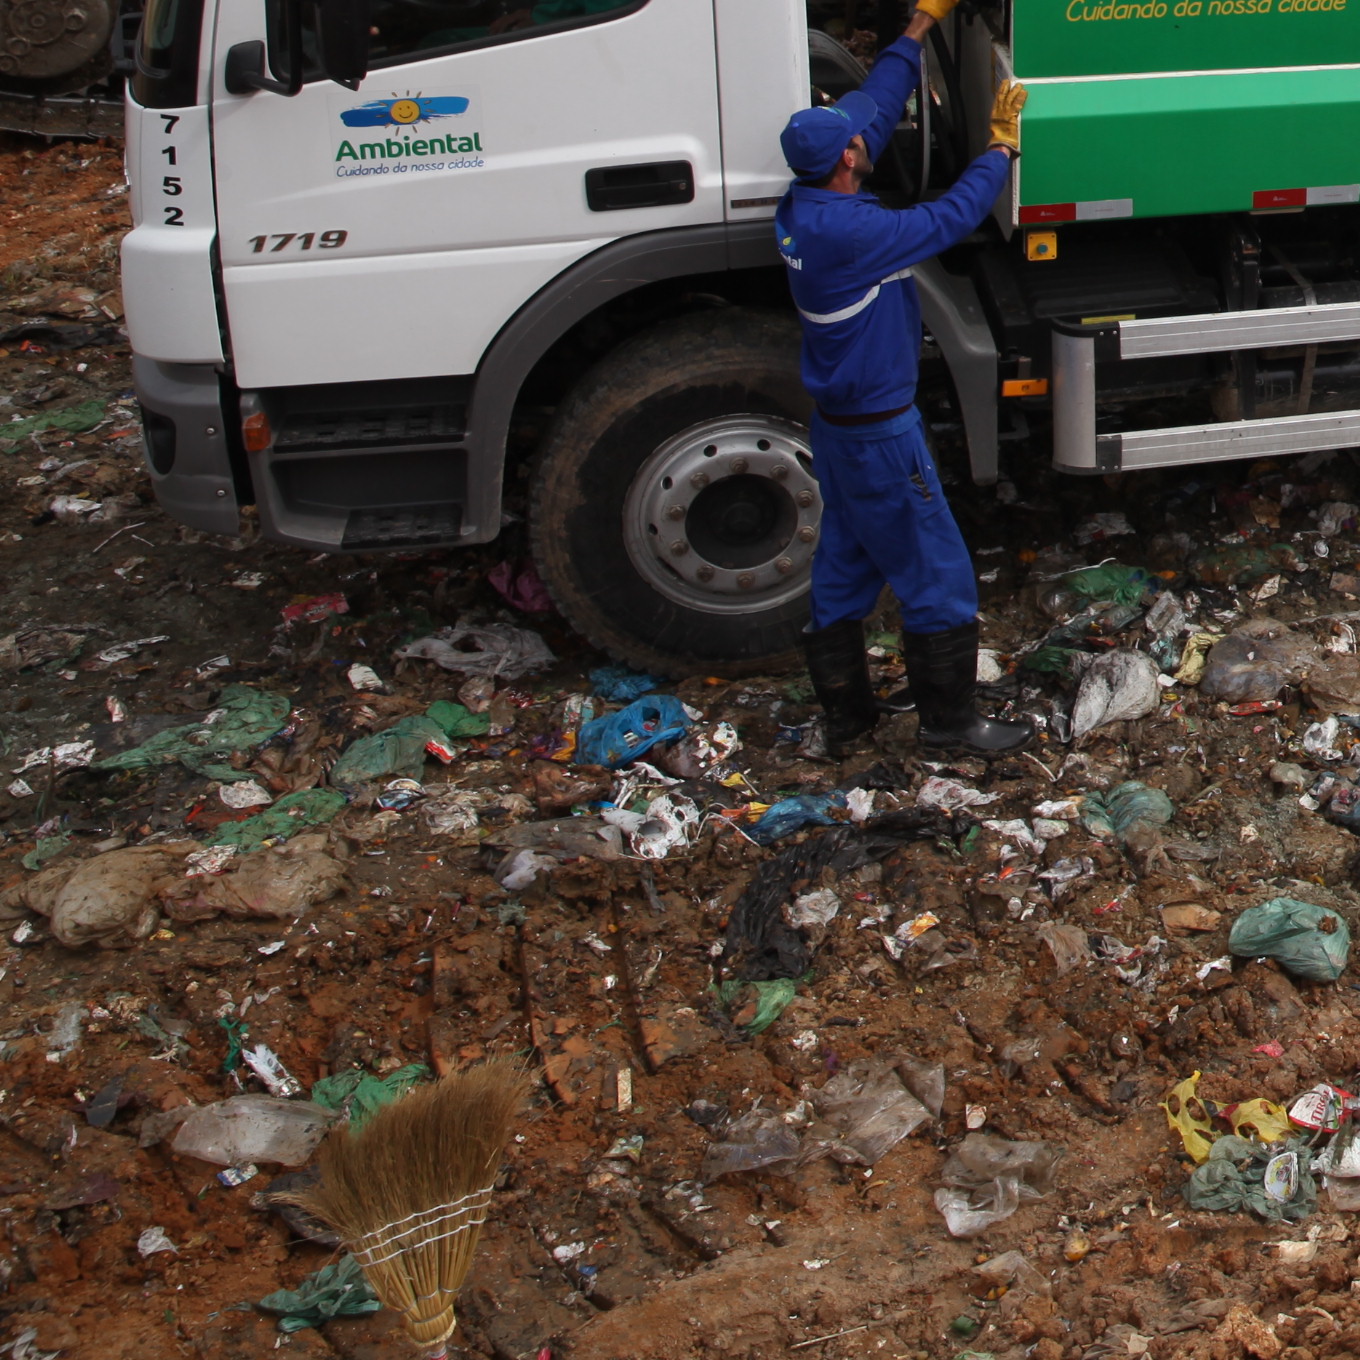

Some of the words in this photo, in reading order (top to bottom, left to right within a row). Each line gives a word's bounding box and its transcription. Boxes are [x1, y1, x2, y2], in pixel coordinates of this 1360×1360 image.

[335, 132, 483, 162] Ambiental
[159, 113, 185, 227] 7152
[336, 162, 390, 178] Cuidando
[392, 161, 408, 174] da
[410, 162, 445, 172] nossa
[447, 155, 485, 169] cidade
[247, 229, 349, 254] 1719
